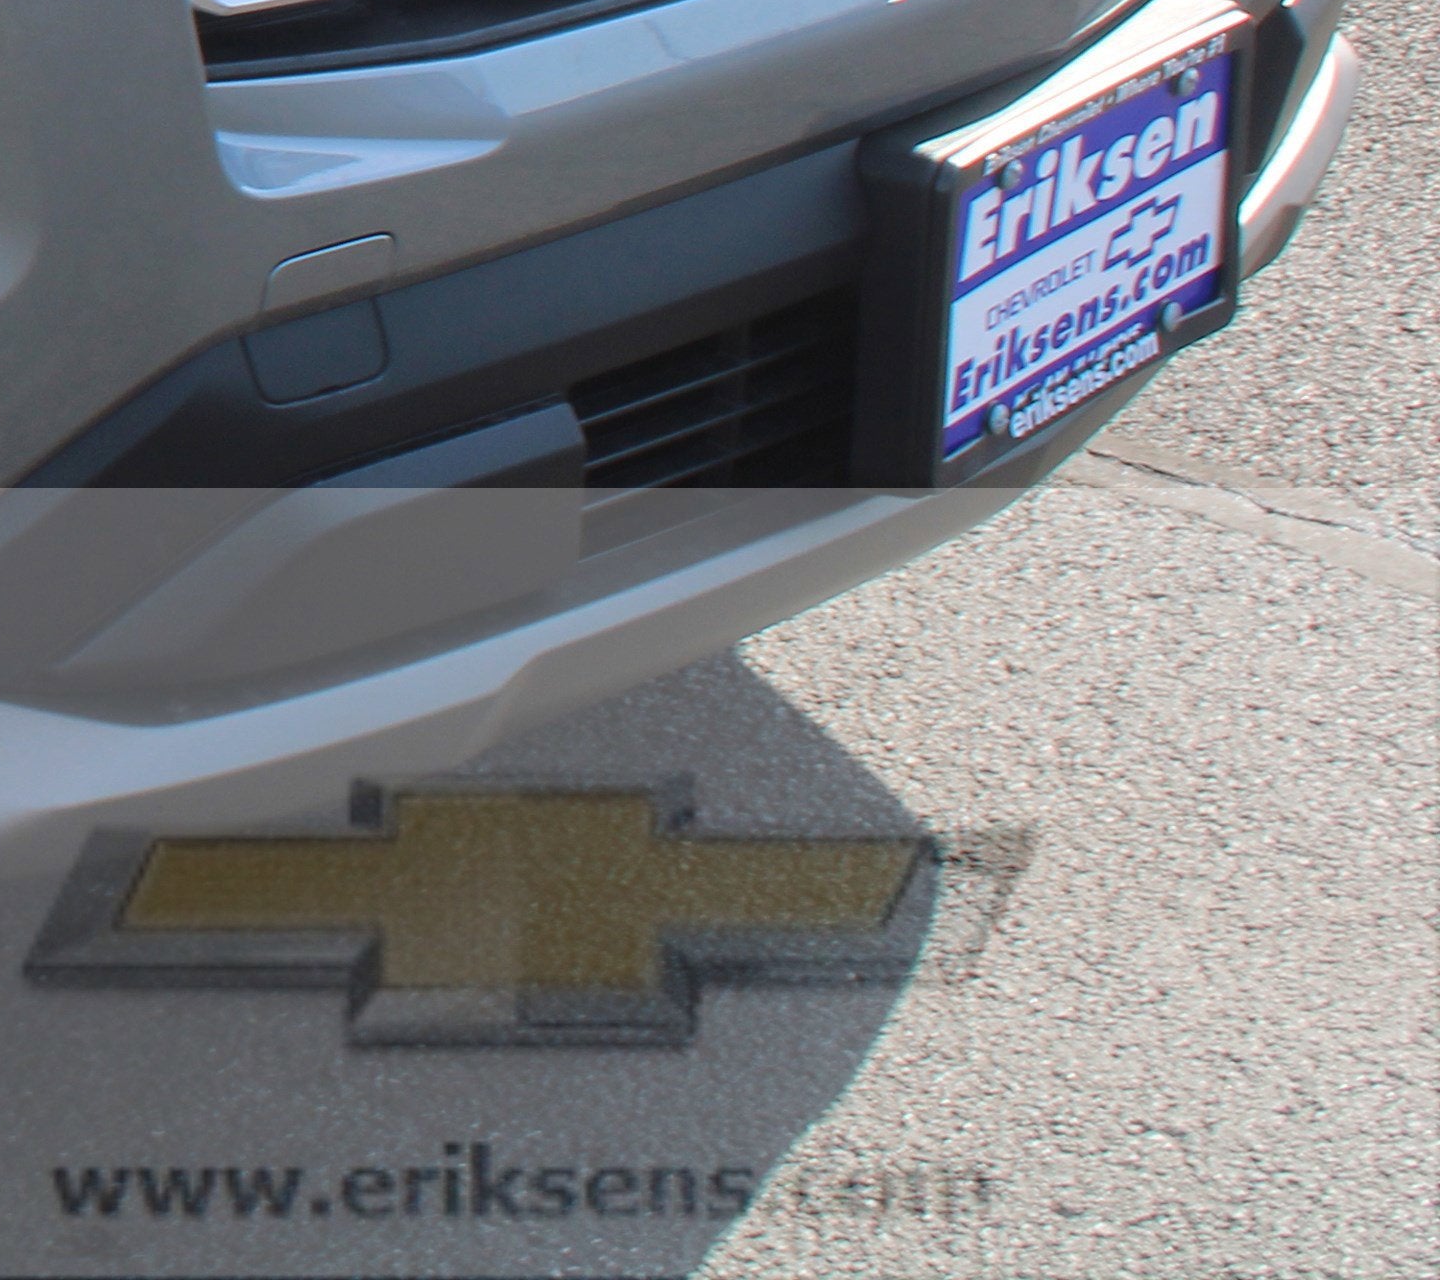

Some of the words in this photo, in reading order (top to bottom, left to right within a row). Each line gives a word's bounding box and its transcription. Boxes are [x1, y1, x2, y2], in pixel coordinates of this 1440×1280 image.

[958, 90, 1220, 283] Eriksen
[950, 233, 1211, 413] Eriksens.com
[985, 248, 1098, 331] CHEVROLET
[1009, 331, 1160, 438] eriksens.com
